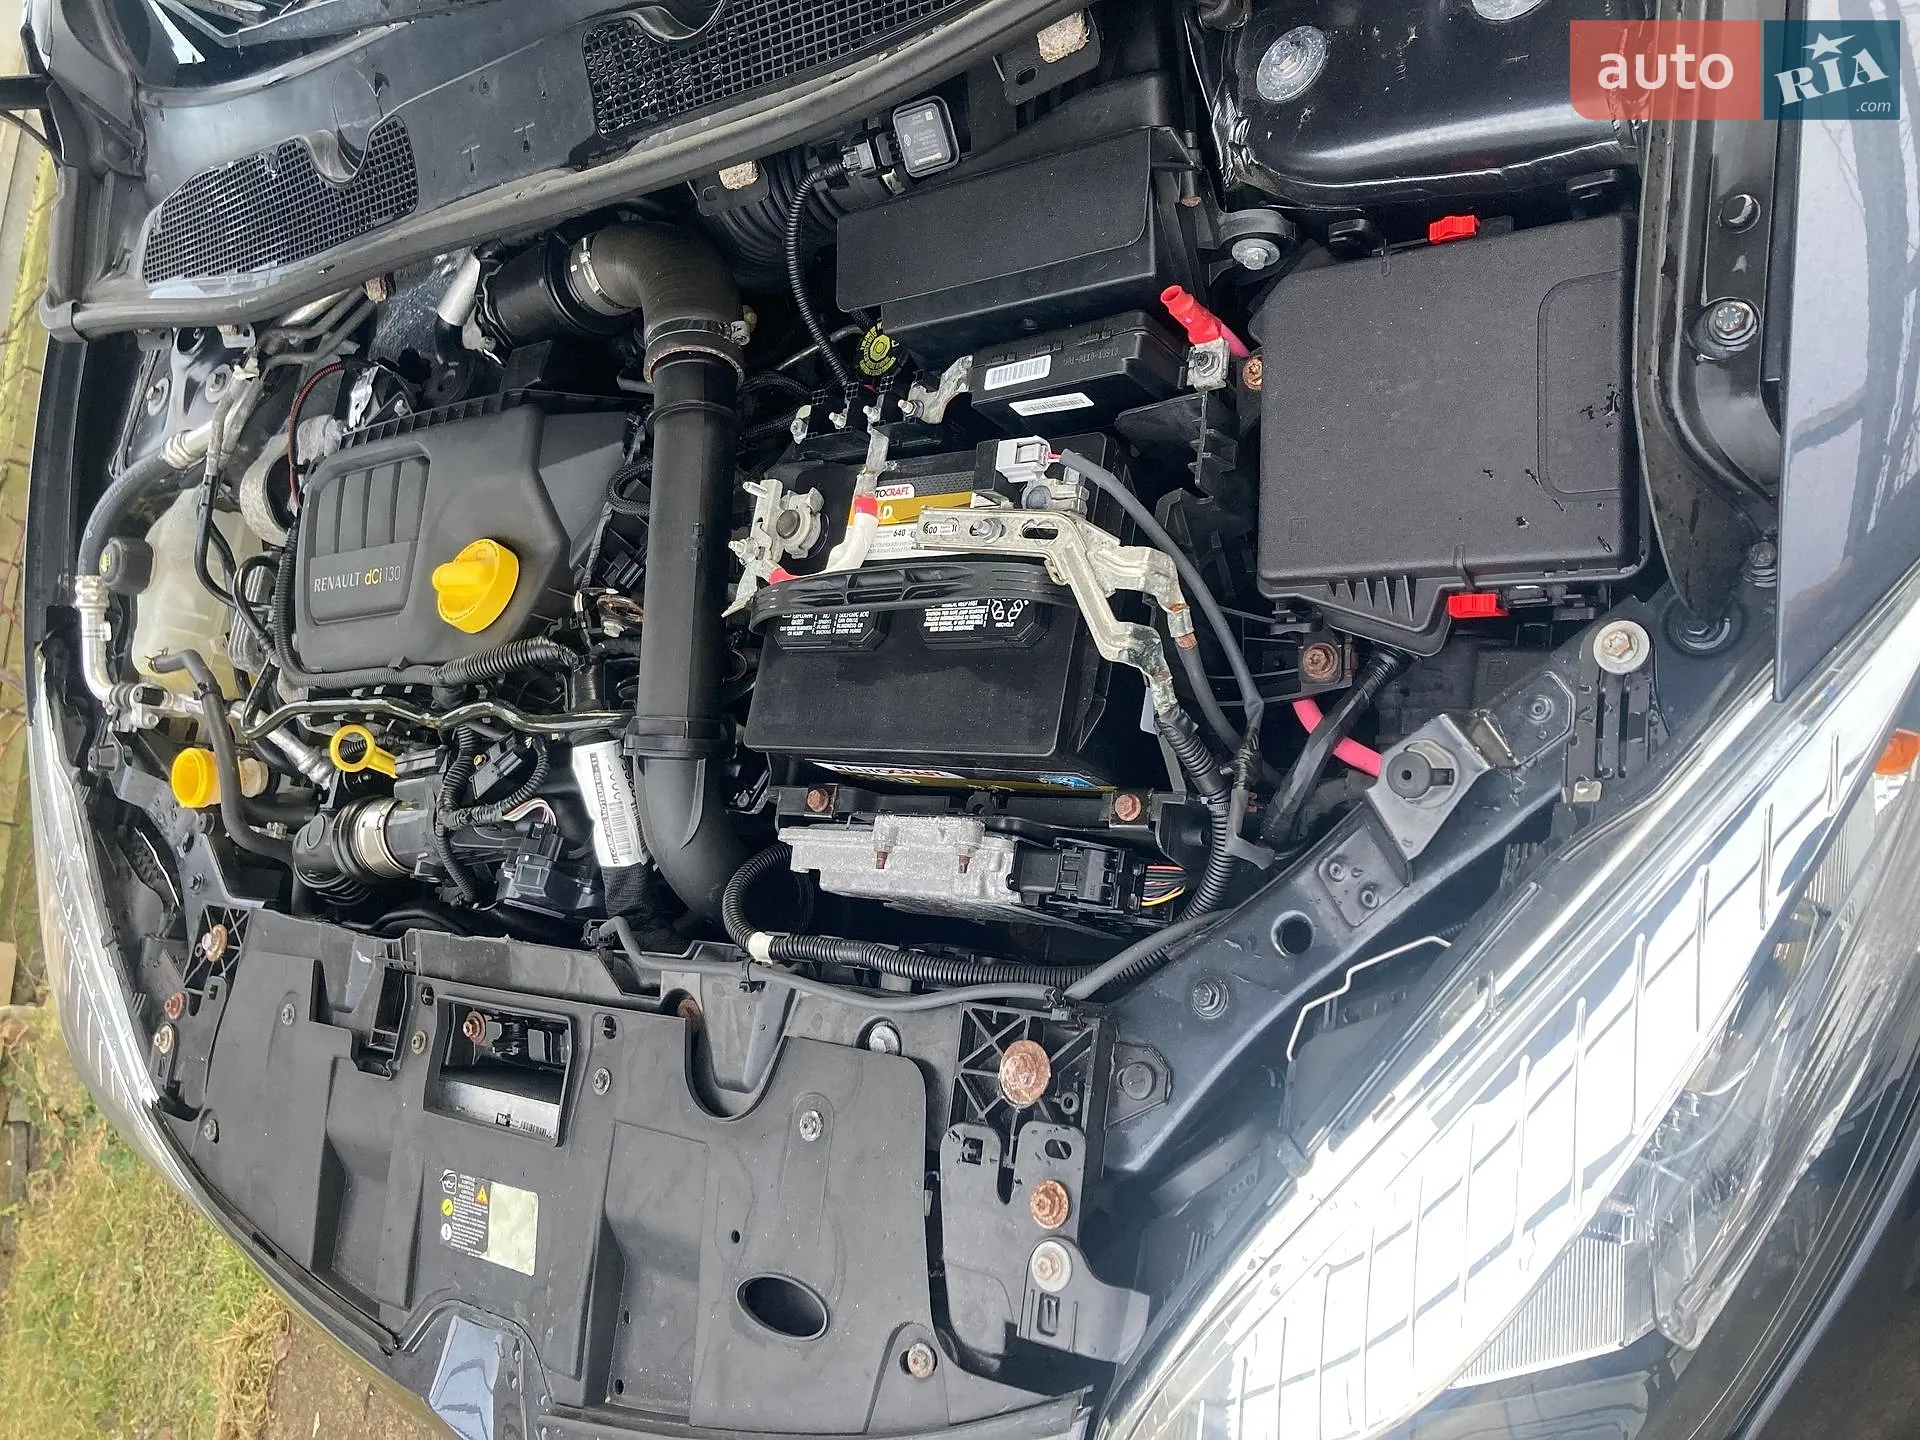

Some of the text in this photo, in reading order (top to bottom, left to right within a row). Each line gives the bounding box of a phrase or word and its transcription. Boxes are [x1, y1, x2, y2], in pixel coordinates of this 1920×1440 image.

[876, 486, 910, 498] TOCRAFT
[893, 528, 906, 538] 640
[313, 565, 401, 593] RENAULT dCi 130
